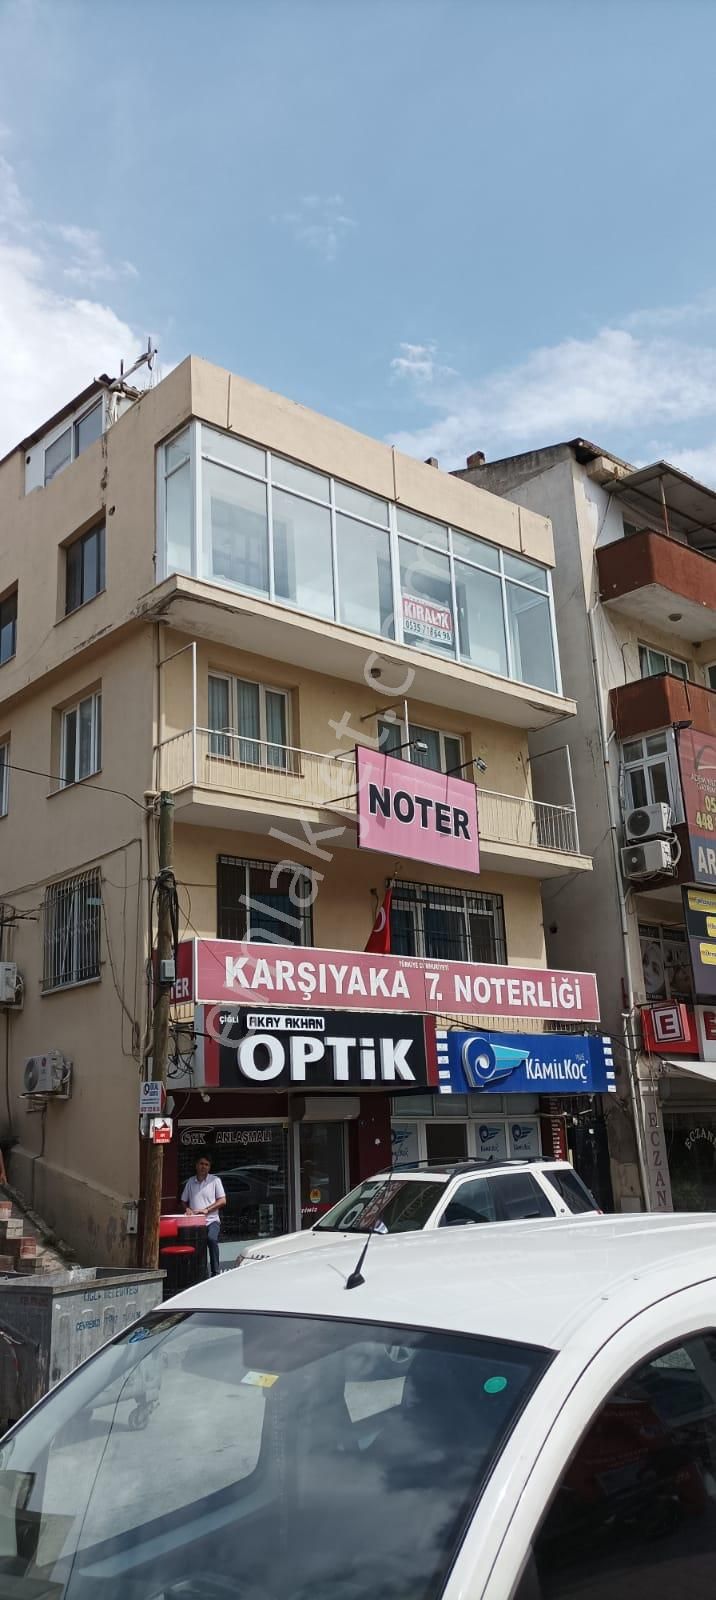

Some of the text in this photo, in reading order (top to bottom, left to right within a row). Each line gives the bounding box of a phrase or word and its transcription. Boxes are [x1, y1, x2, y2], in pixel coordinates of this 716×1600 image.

[368, 782, 472, 841] NOTER
[225, 956, 582, 1010] KARŞIYAKA 7. NOTERLİĞİ
[249, 1016, 281, 1028] AKAY
[285, 1017, 324, 1030] AKHAN
[659, 1013, 676, 1035] E
